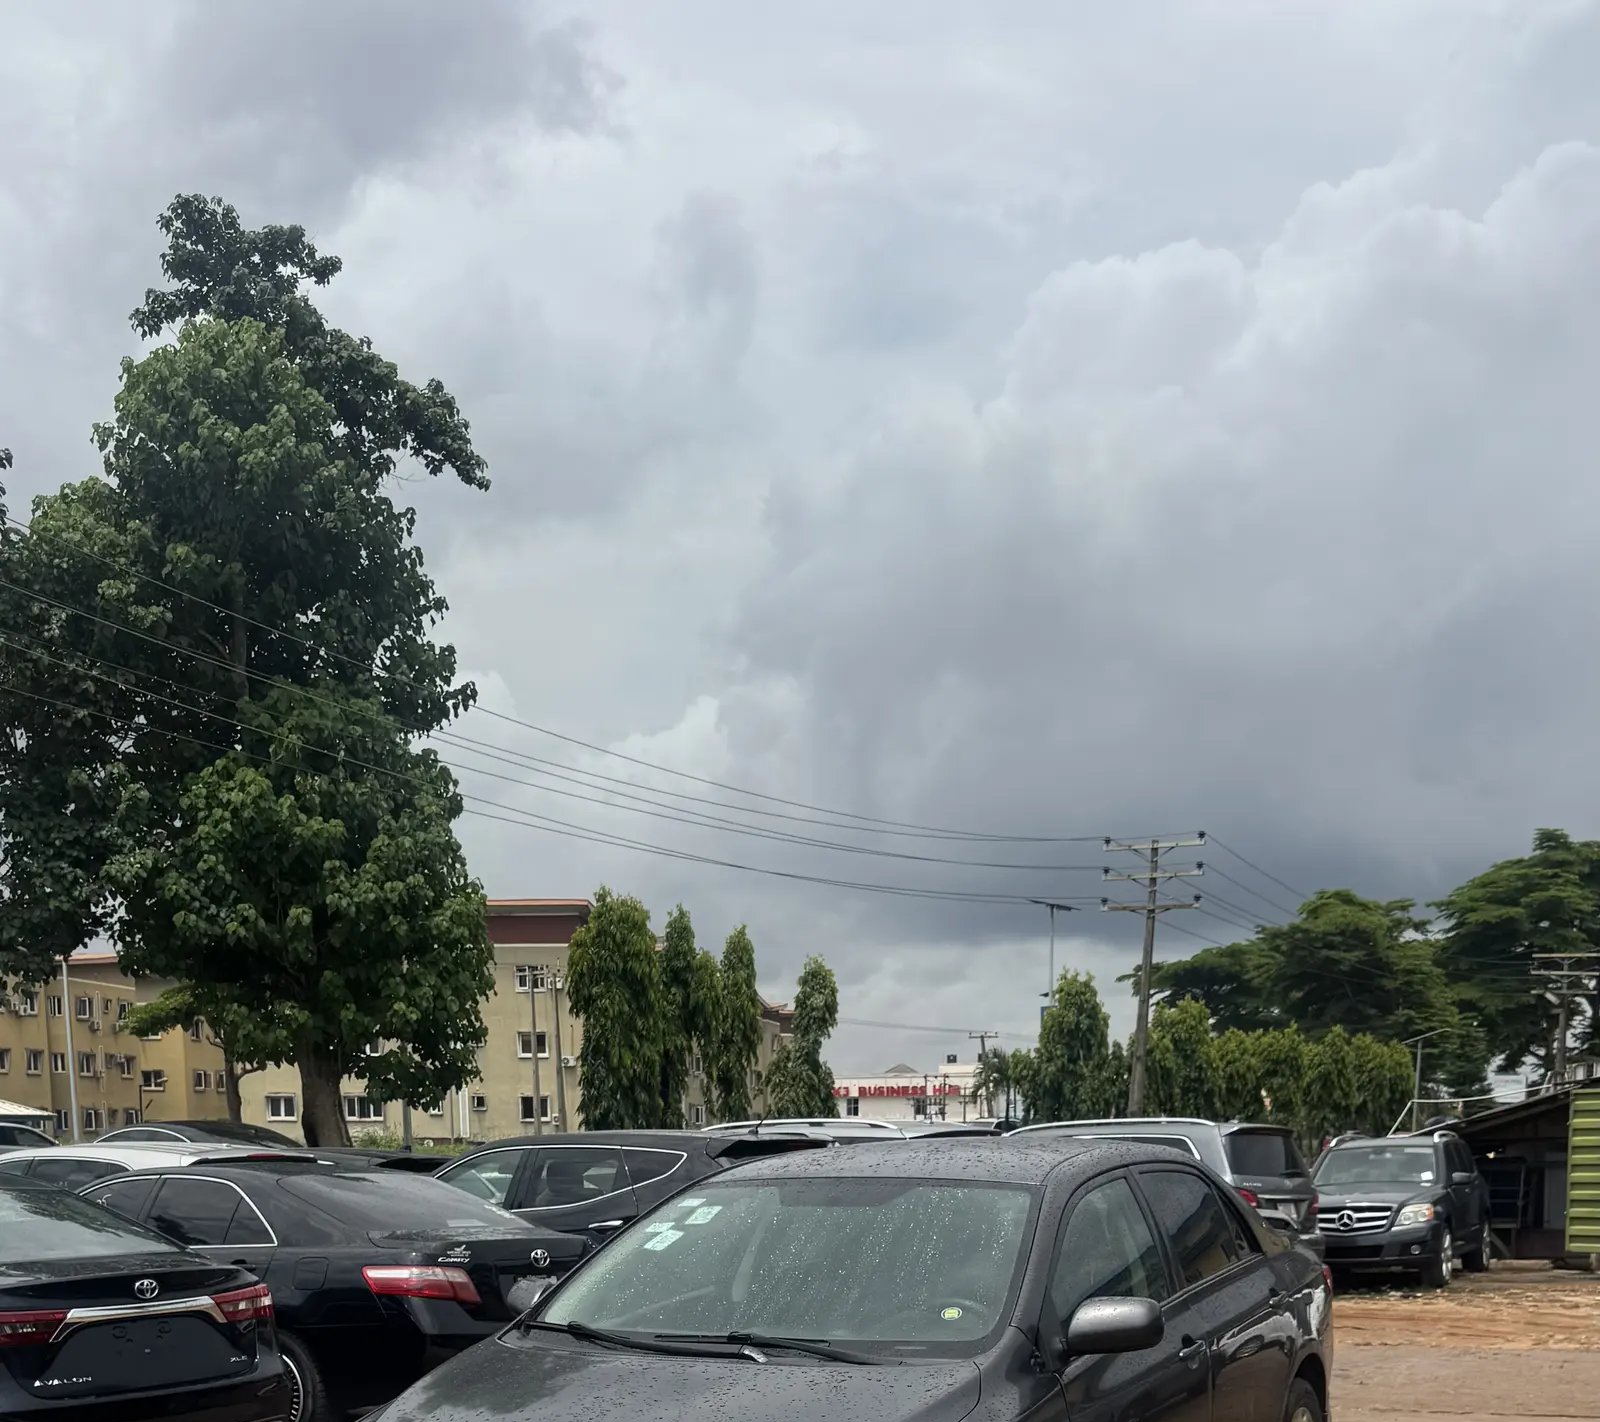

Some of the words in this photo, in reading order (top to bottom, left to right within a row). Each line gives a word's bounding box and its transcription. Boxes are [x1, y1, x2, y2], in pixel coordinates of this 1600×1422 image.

[858, 1085, 926, 1098] BUSINESS
[933, 1084, 961, 1097] HUB
[229, 1355, 248, 1363] XLE
[33, 1375, 92, 1388] AVALON
